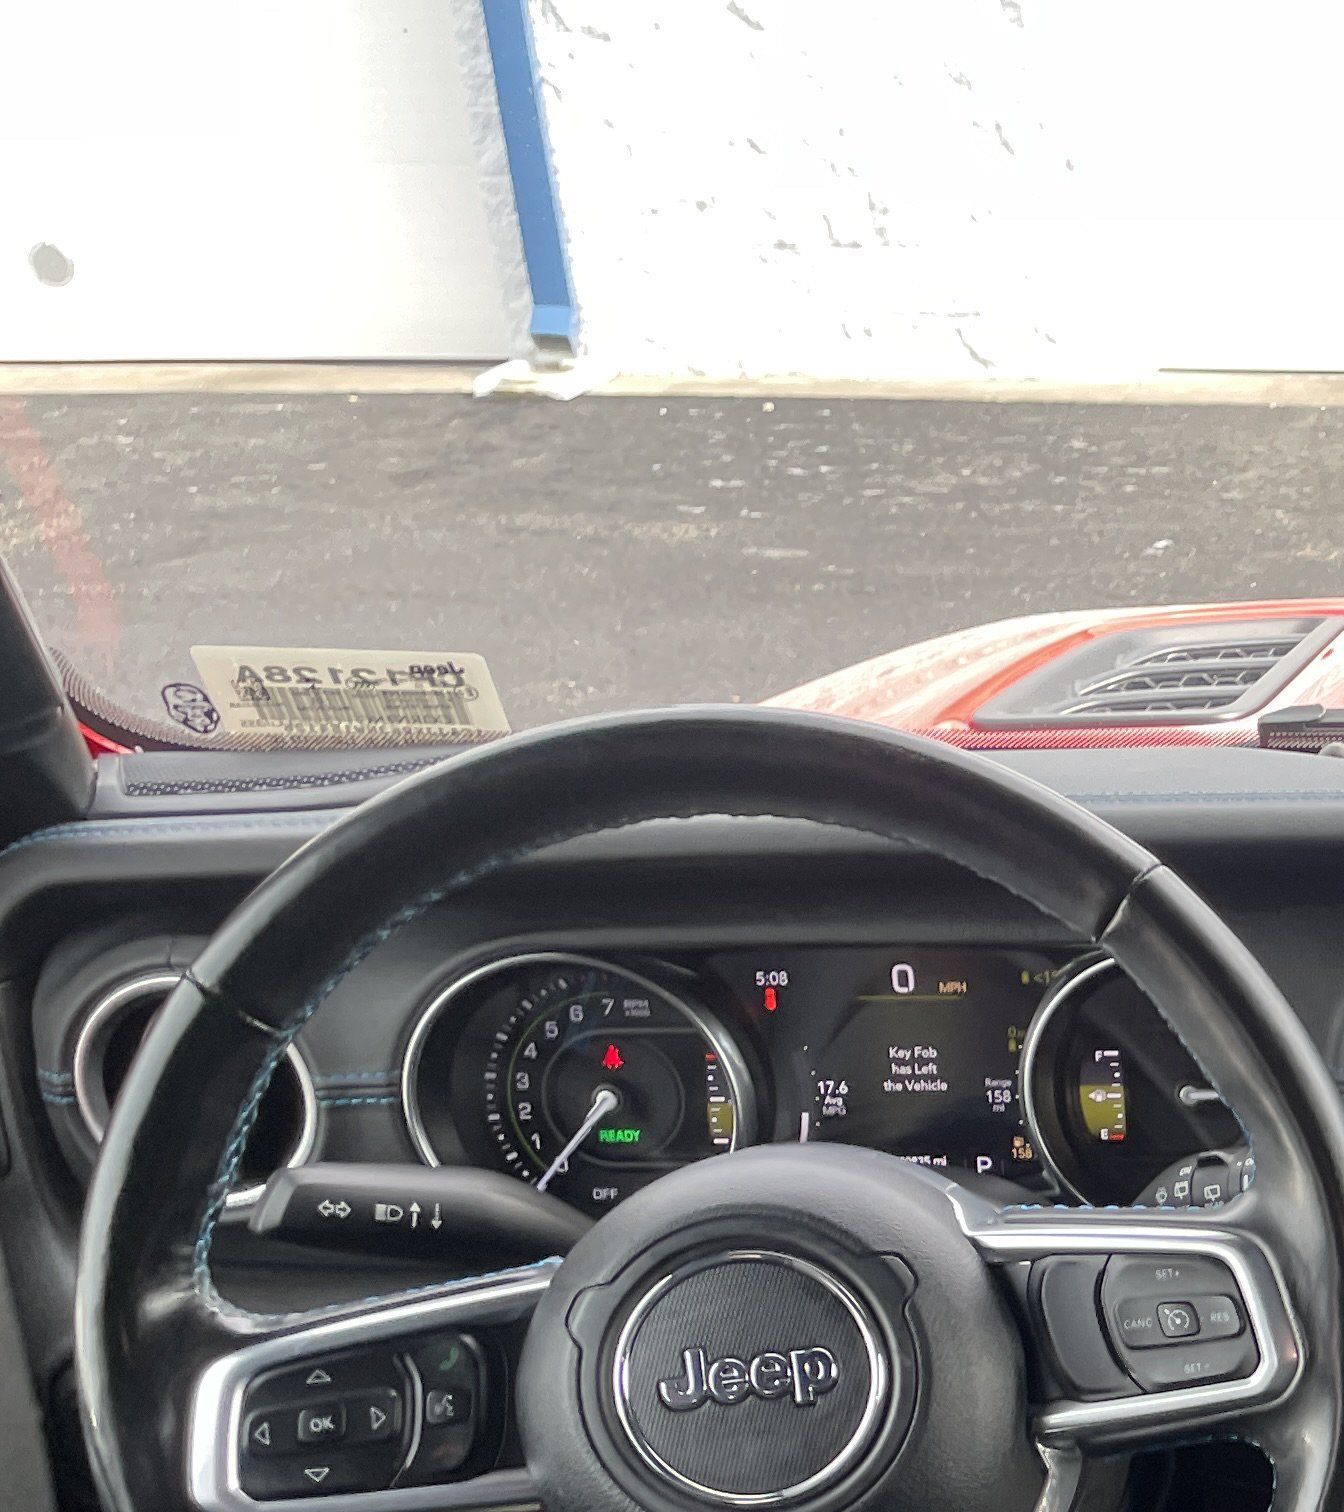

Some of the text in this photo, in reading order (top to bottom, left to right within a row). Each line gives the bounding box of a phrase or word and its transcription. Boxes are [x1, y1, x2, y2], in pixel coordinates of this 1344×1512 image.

[755, 971, 789, 986] 5:08
[891, 963, 914, 994] 0
[939, 981, 967, 993] MPH
[568, 1005, 583, 1022] 6
[601, 998, 615, 1015] 7
[545, 1021, 559, 1038] 5
[524, 1043, 538, 1060] 4
[889, 1046, 938, 1061] Key Fob
[891, 1062, 938, 1075] has Left
[516, 1072, 530, 1089] 3
[818, 1080, 849, 1095] 17.6
[883, 1079, 948, 1092] the Vehicle
[986, 1089, 1012, 1104] 158
[518, 1102, 532, 1121] 2
[531, 1132, 541, 1150] 1
[599, 1130, 641, 1143] READY
[976, 1156, 993, 1174] P
[593, 1188, 619, 1200] OFF
[657, 1346, 839, 1413] Jeep
[309, 1415, 335, 1432] OK
